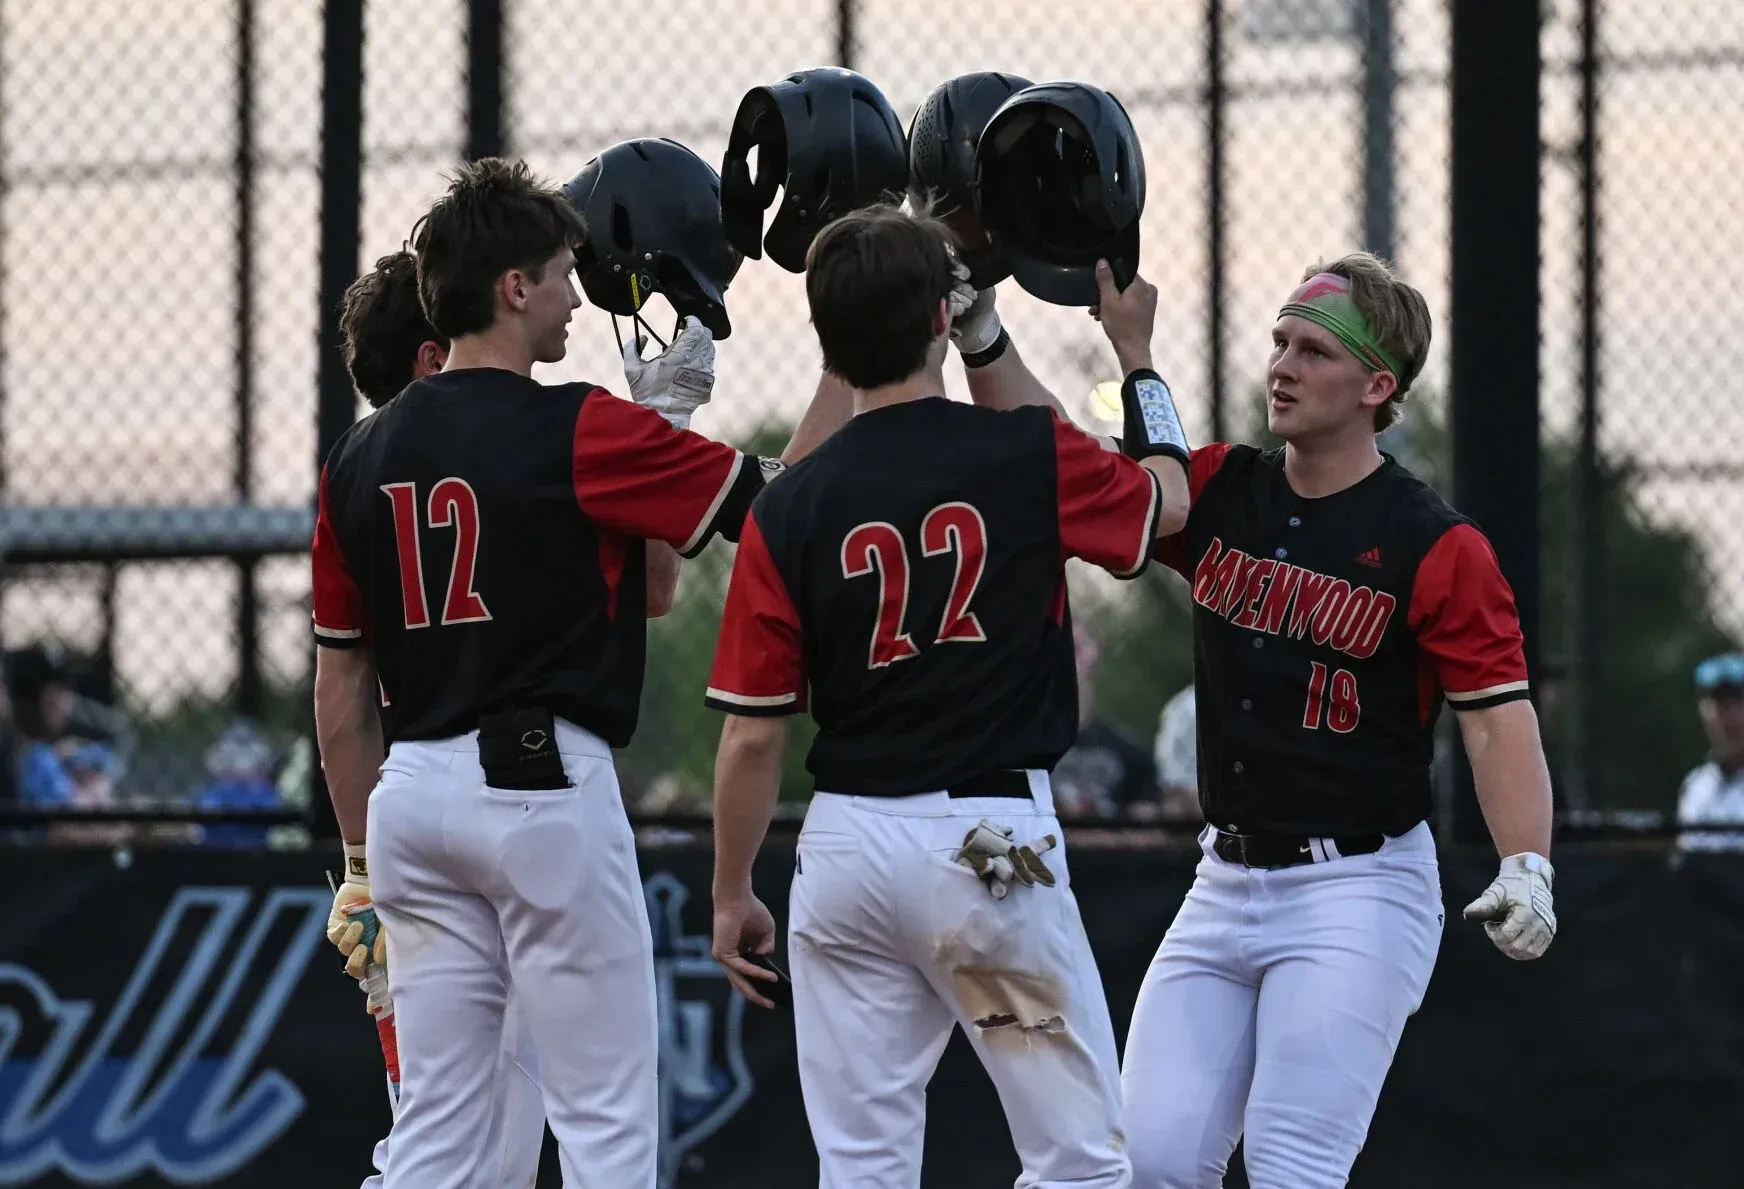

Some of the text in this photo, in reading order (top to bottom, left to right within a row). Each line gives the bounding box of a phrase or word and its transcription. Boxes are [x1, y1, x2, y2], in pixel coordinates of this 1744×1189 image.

[379, 477, 493, 630] 12
[841, 501, 988, 670] 22
[1193, 536, 1397, 659] RAVENWOOD
[1302, 661, 1361, 734] 18
